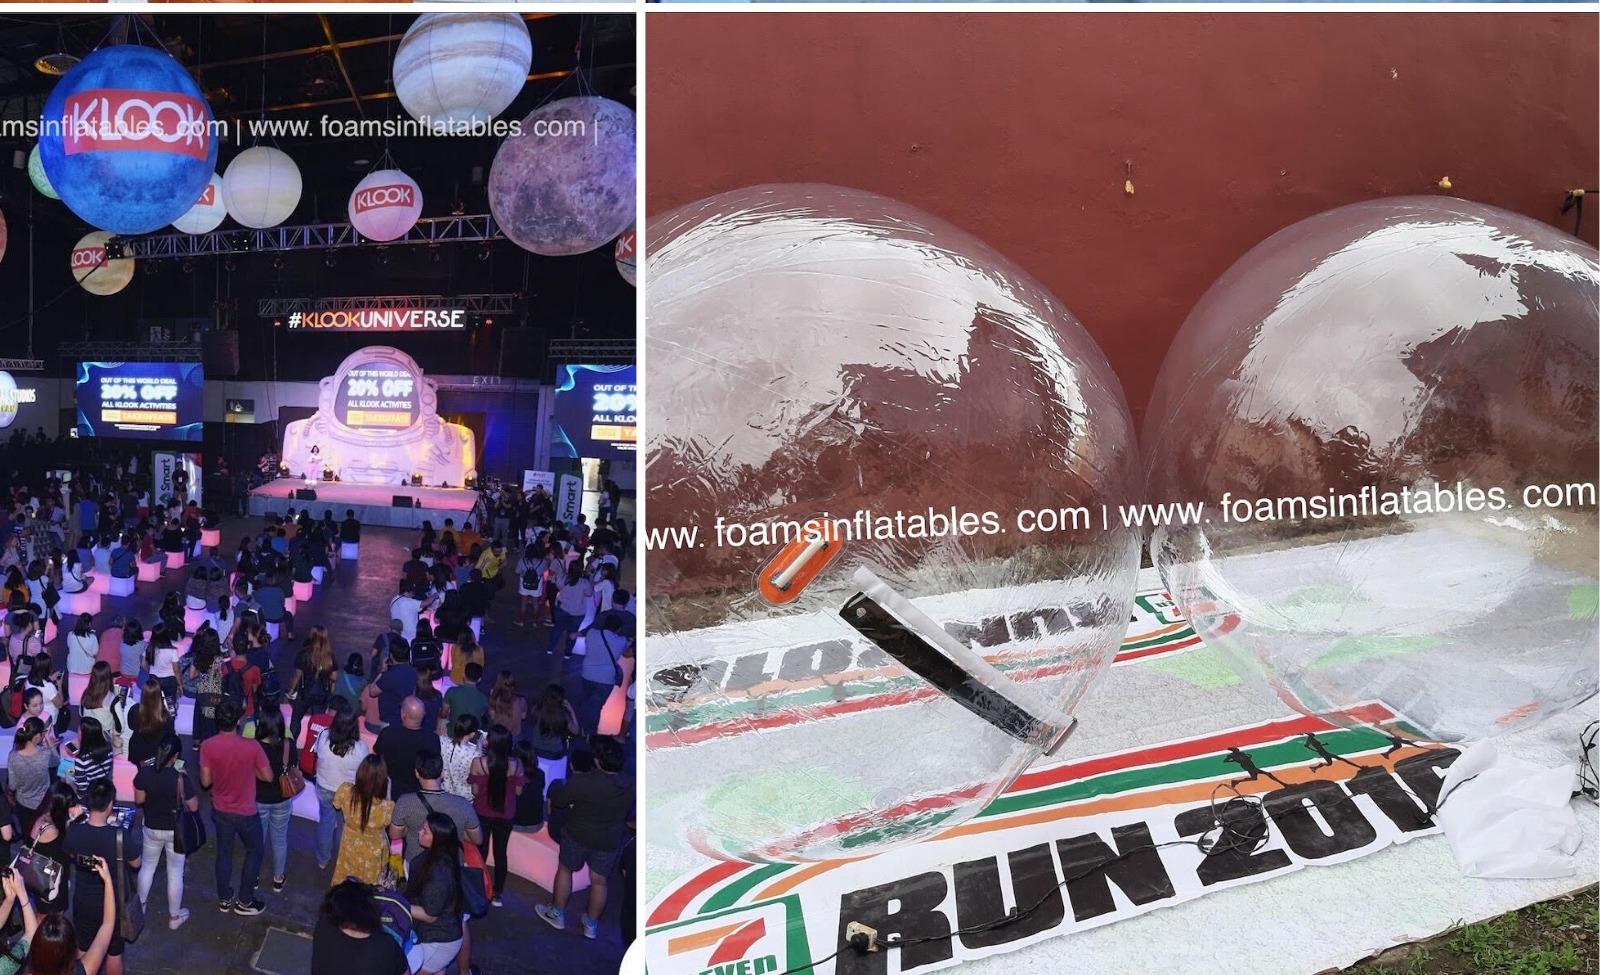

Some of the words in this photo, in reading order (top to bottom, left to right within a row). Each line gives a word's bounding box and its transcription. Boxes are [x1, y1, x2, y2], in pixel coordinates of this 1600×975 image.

[72, 95, 205, 150] KLOOK
[356, 186, 411, 209] KLOOK
[288, 309, 465, 330] #KLOOKUNIVERSE
[100, 384, 138, 400] 20%
[140, 385, 178, 400] OFF
[347, 380, 381, 397] 20%
[382, 380, 414, 397] OFF
[593, 384, 613, 392] OUT
[614, 384, 628, 392] OF
[101, 401, 114, 409] ALL
[140, 402, 177, 410] ACTIVITIES
[380, 401, 412, 410] ACTIVITIES
[592, 414, 613, 423] ALL
[161, 458, 171, 492] Smart
[563, 480, 578, 520] Smart
[835, 821, 1175, 975] RUN
